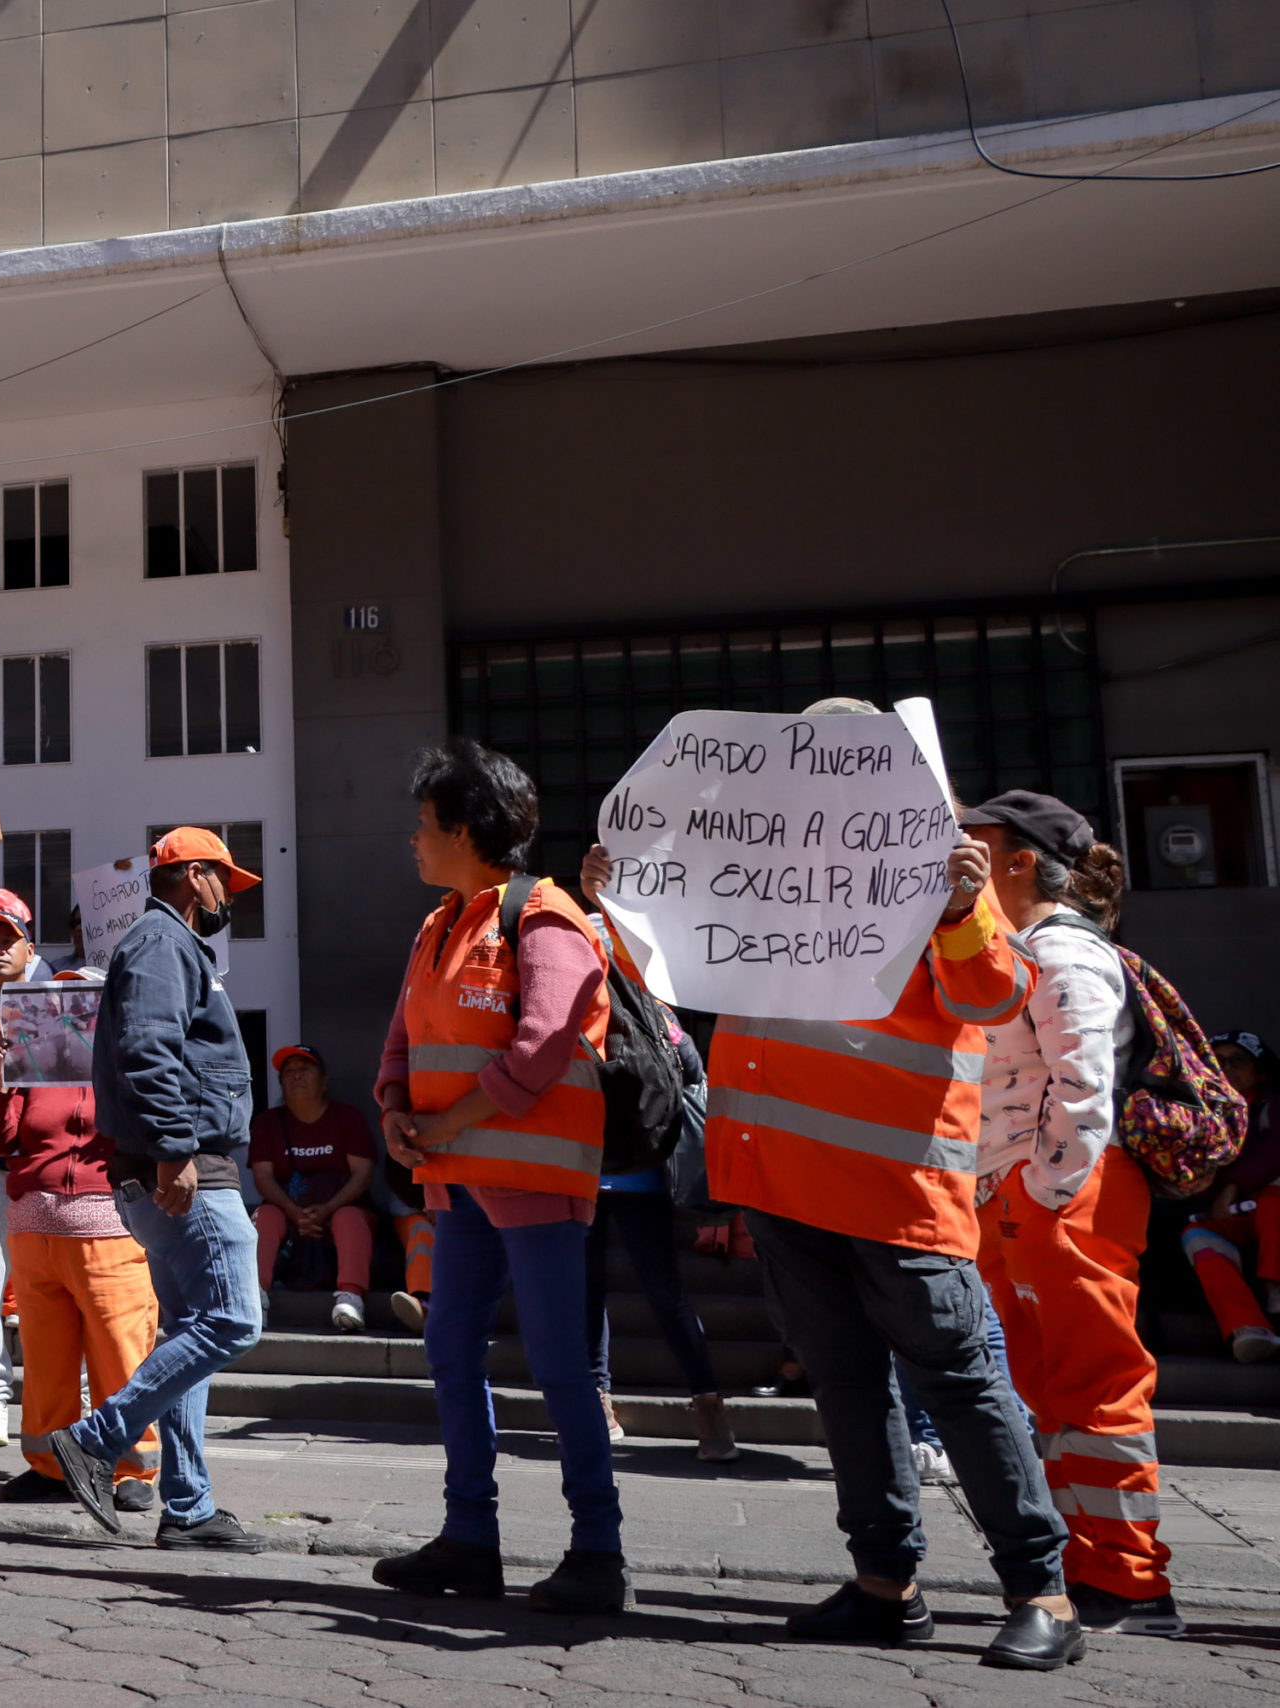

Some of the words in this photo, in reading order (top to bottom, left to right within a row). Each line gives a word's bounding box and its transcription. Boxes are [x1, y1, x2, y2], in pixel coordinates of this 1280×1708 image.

[350, 606, 379, 629] 116
[781, 721, 892, 776] RIVERA
[607, 787, 667, 832] NOS
[685, 808, 786, 848] MANDA
[803, 811, 824, 848] A
[92, 880, 140, 911] EDUARDO
[610, 856, 688, 899] POR
[710, 863, 853, 909] EXIGIR
[85, 922, 104, 943] NOS
[694, 923, 885, 967] DERECHOS
